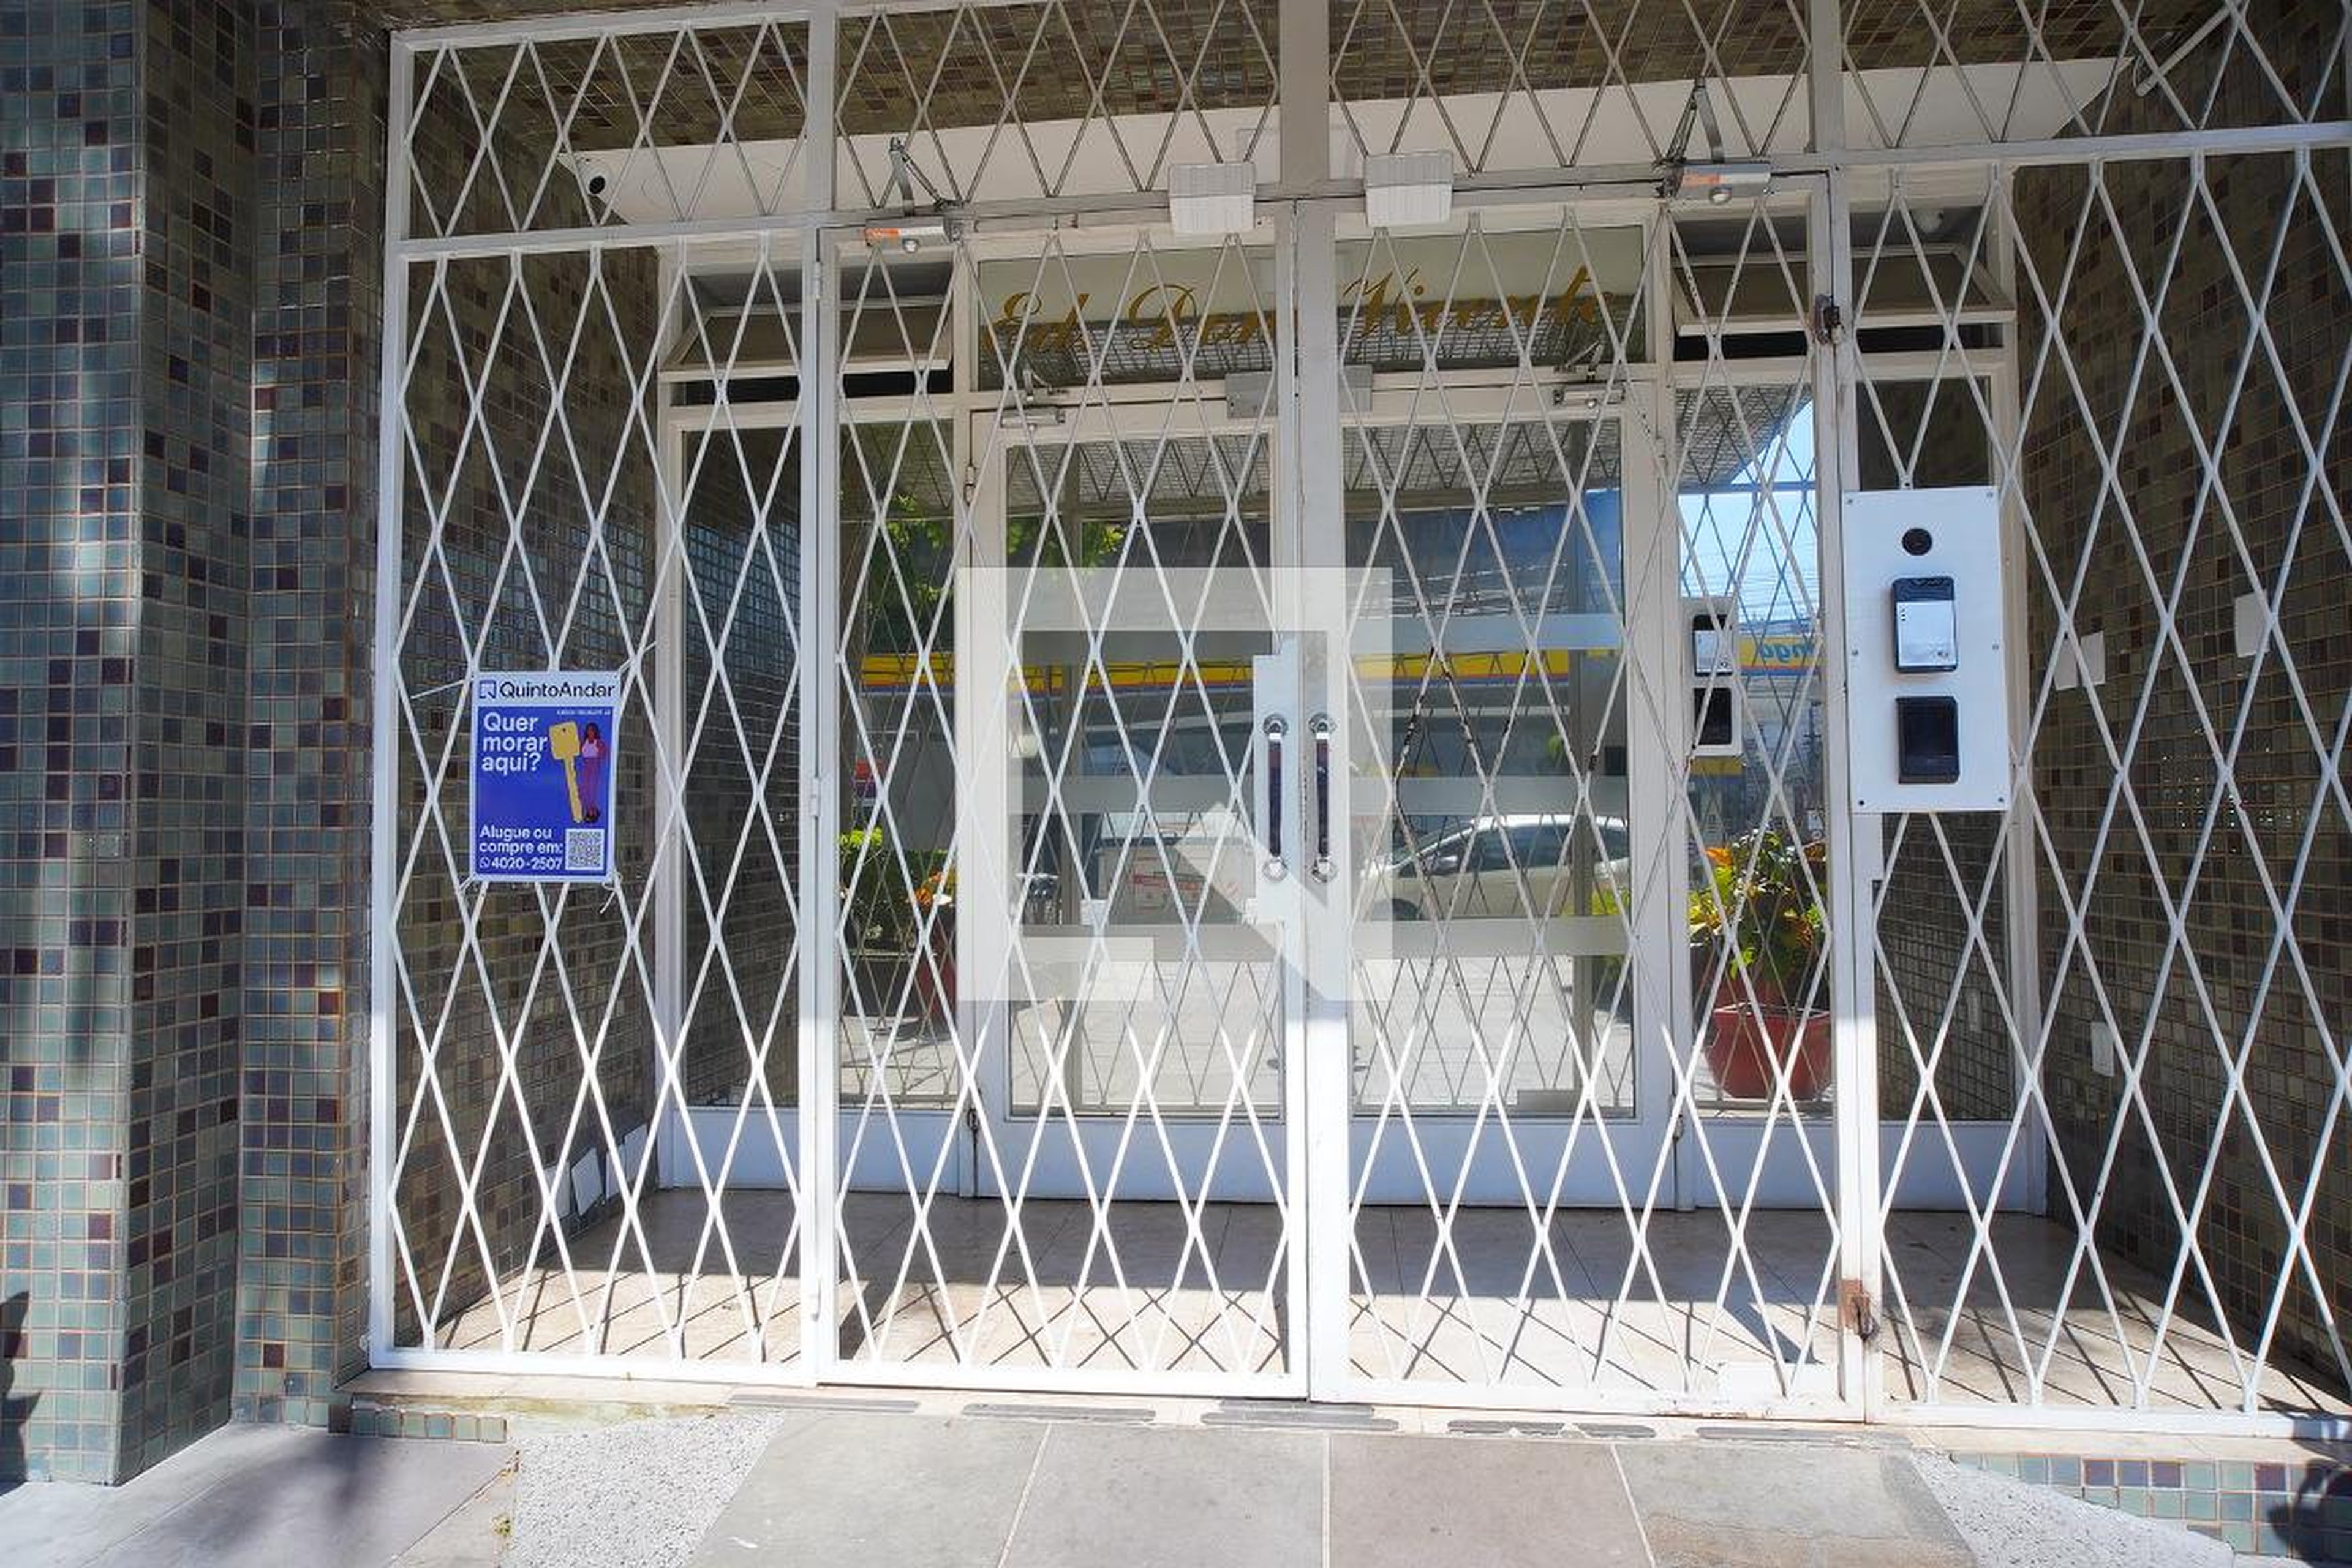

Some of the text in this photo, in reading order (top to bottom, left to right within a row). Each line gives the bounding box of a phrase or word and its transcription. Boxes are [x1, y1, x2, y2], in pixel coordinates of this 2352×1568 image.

[499, 681, 616, 698] QuintoAndar
[483, 711, 538, 731] Quer
[482, 736, 548, 752] morar
[481, 752, 541, 776] aqui?
[479, 824, 552, 842] Alugue ou
[479, 842, 564, 856] compre em:
[491, 856, 563, 870] 4020-2507
